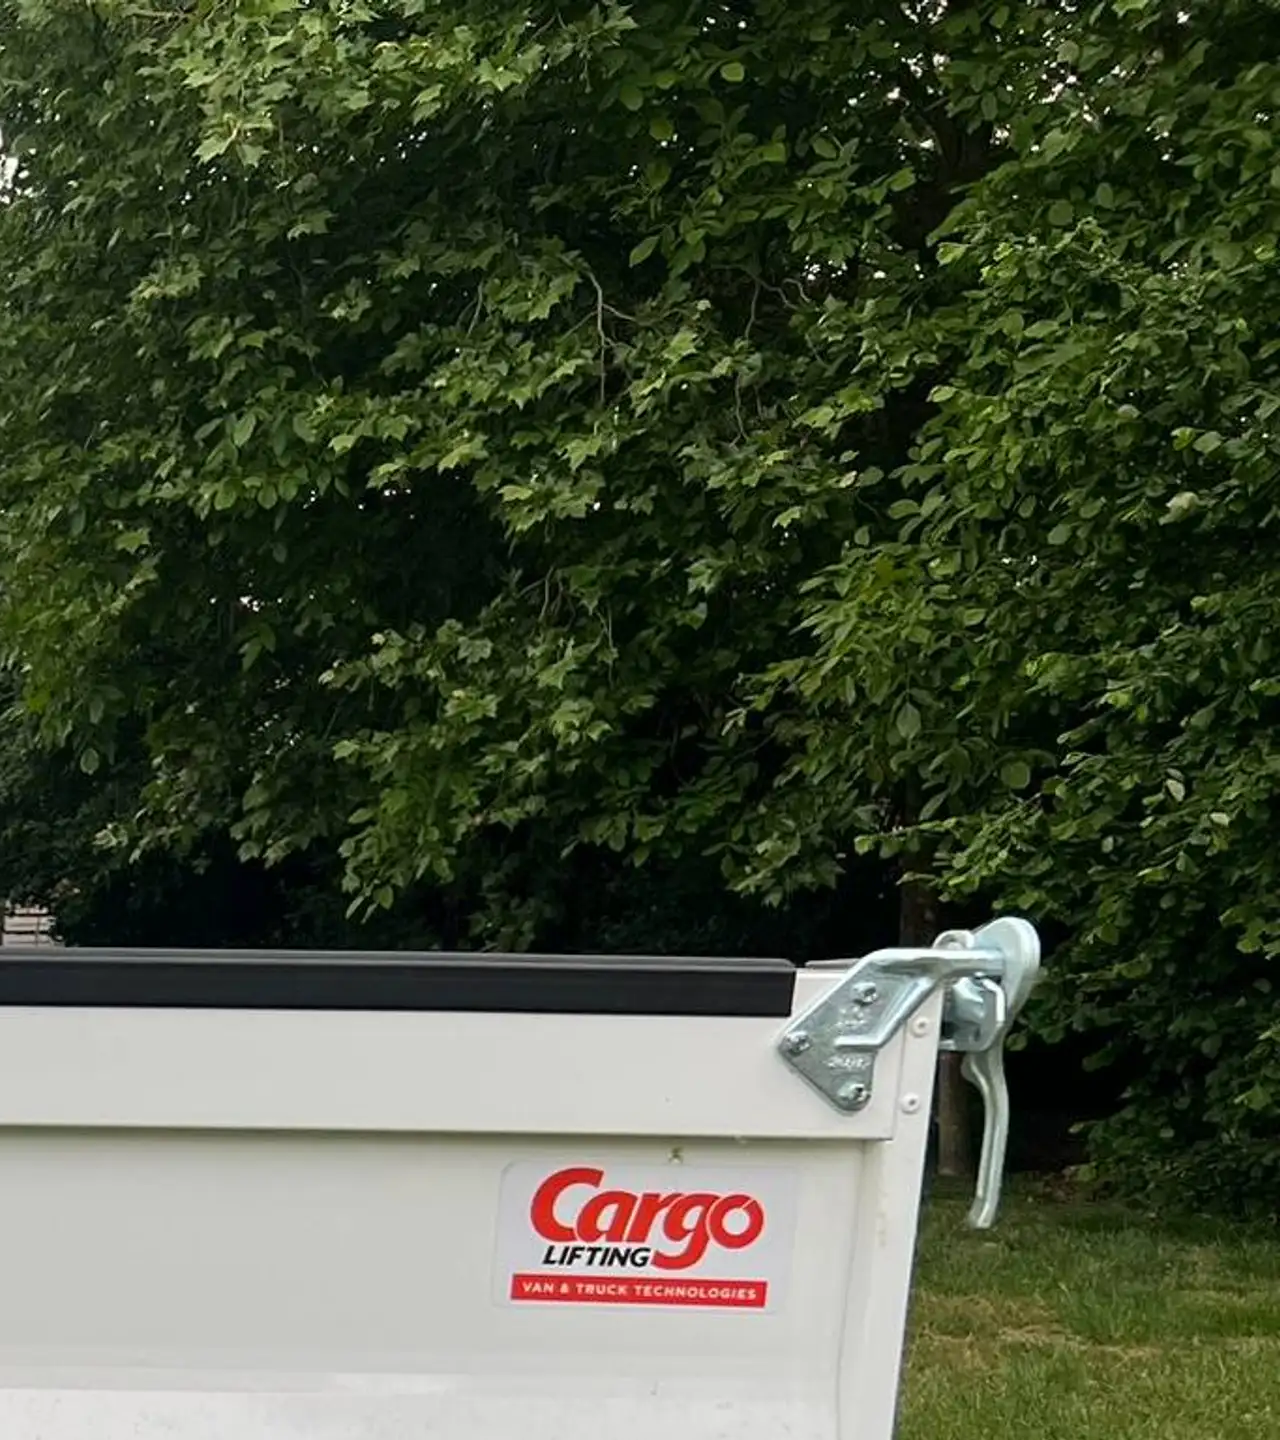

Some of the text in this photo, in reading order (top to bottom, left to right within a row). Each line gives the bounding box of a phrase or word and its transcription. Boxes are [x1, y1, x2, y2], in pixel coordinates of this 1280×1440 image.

[530, 1167, 765, 1271] Cargo
[542, 1245, 652, 1267] LIFTING
[522, 1281, 758, 1300] VAN & TRUCK TECHNOLOGIES
